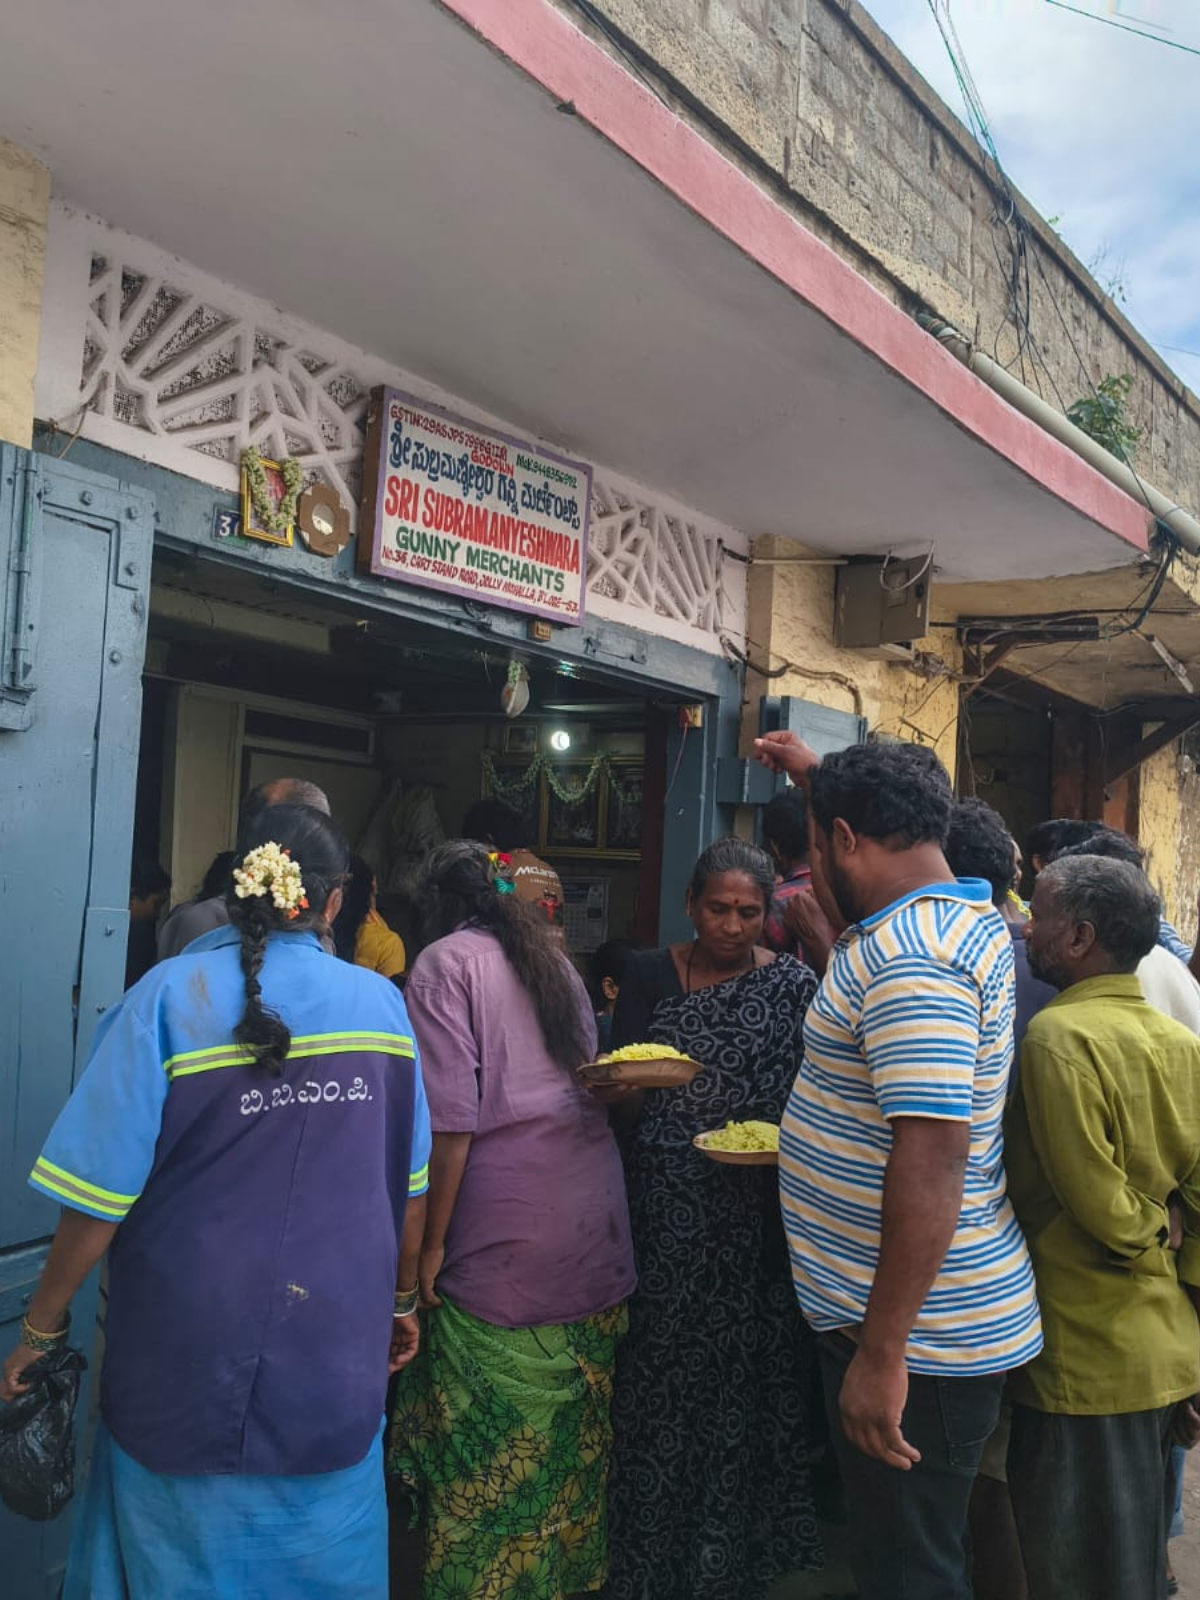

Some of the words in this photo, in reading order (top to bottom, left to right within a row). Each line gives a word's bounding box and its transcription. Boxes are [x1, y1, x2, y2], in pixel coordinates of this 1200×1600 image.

[389, 419, 411, 469] ಶ್ರೀ
[471, 450, 515, 477] GODOWN
[219, 515, 239, 537] 3
[385, 475, 420, 523] SRI
[422, 487, 580, 575] SUBRAMANYESHWARA
[396, 526, 461, 564] GUNNY
[466, 546, 565, 592] MERCHANTS
[431, 560, 459, 579] STAND
[240, 1077, 373, 1115] ಬಿ.ಬಿ.ಎಂ.ಪಿ.
